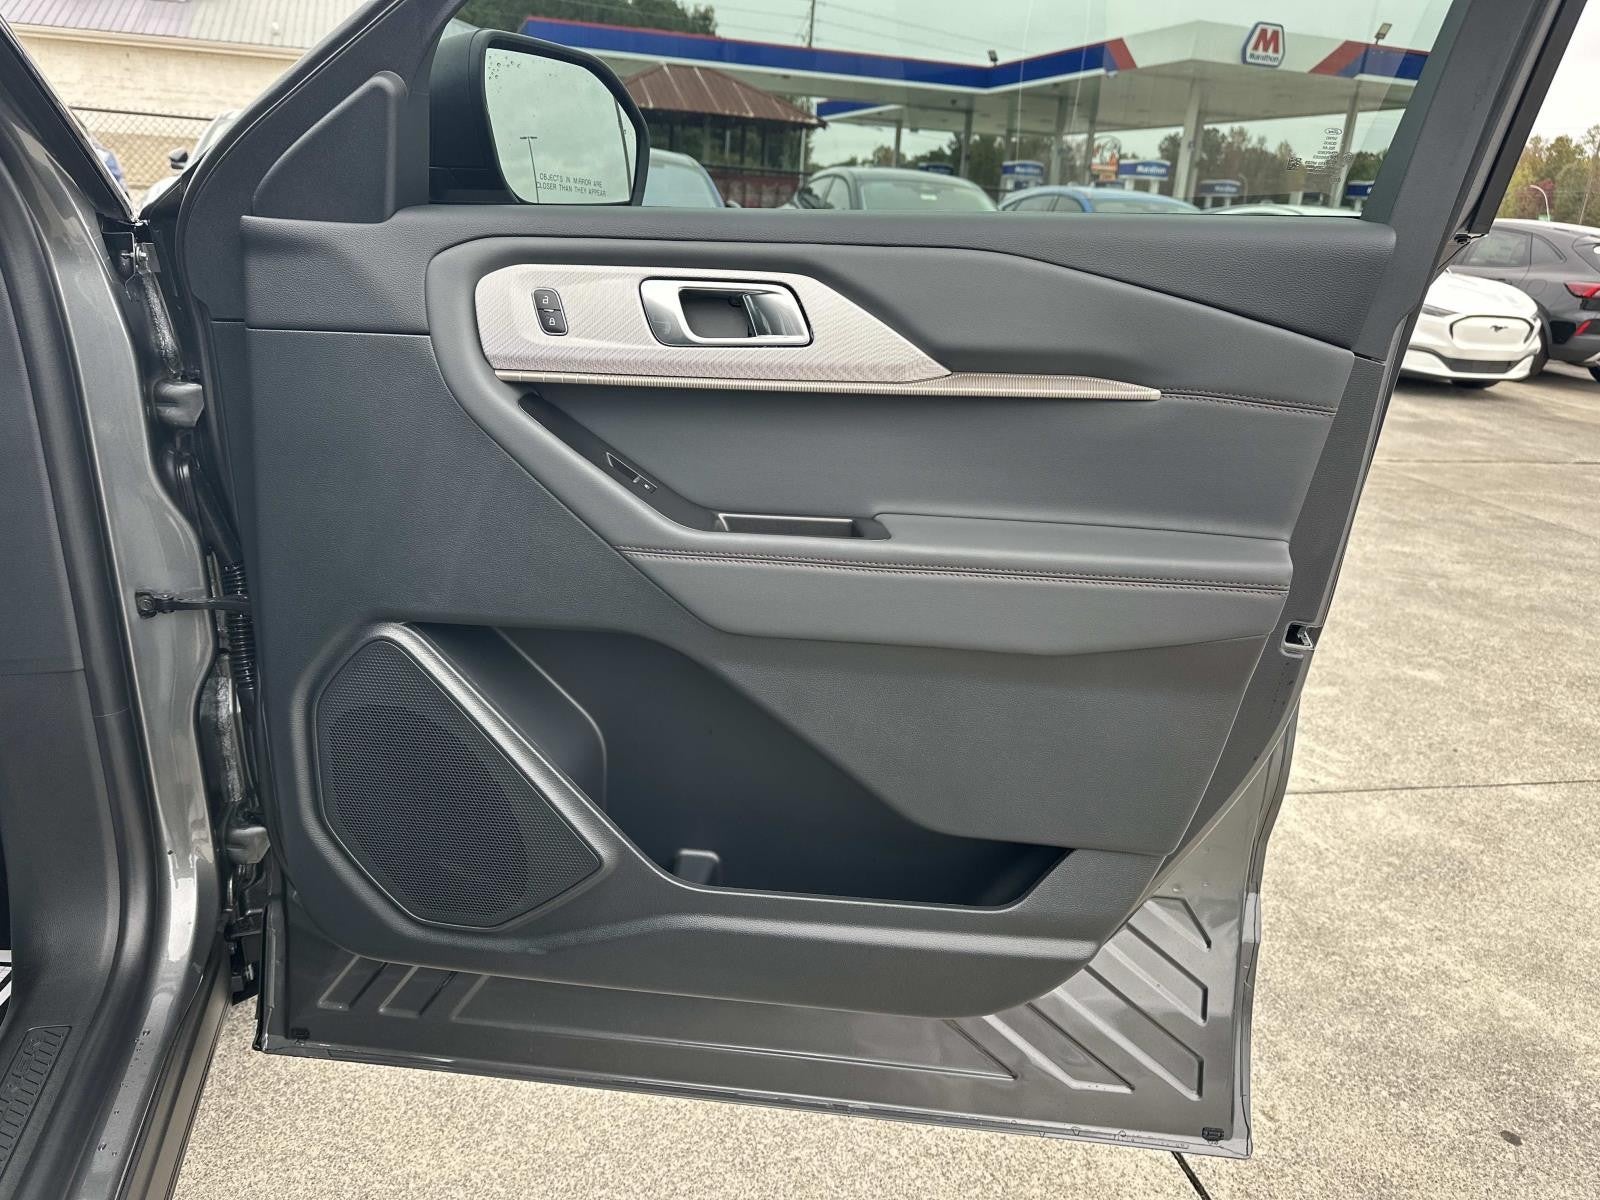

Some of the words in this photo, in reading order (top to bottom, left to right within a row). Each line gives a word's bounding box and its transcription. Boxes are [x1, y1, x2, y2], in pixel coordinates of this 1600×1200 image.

[1252, 29, 1279, 54] M
[1249, 53, 1279, 62] Marathon
[540, 172, 563, 182] OBJECTS
[573, 176, 592, 186] MIRROR
[593, 180, 602, 188] ARE
[536, 181, 557, 190] CLOSER
[559, 183, 573, 192] THAN
[574, 185, 587, 194] THEY
[588, 188, 607, 198] APPEAR
